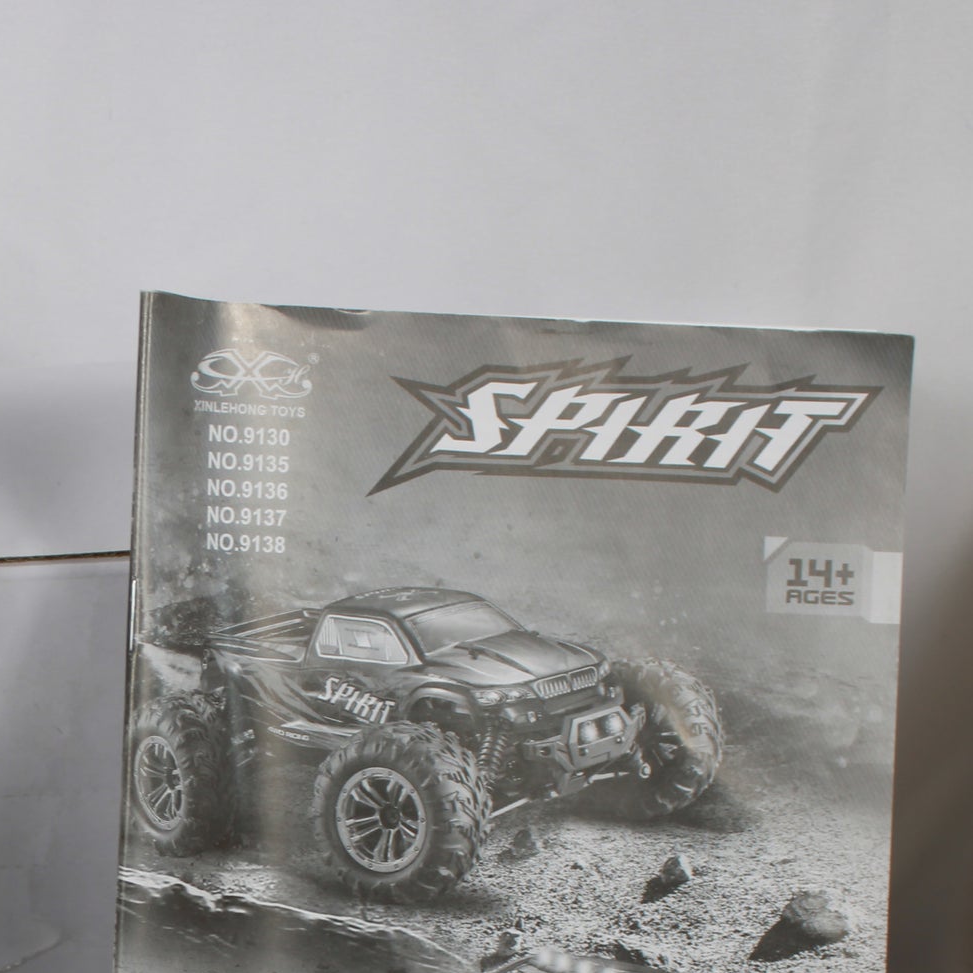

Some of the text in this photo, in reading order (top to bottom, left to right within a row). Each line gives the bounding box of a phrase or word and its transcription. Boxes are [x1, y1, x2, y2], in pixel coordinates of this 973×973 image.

[193, 399, 306, 418] XINLEHONG TOYS
[208, 424, 290, 447] NO.9130
[430, 381, 852, 472] SPIRIT
[207, 451, 289, 473] NO.9135
[207, 478, 288, 500] NO.9136
[206, 505, 287, 526] NO.9137
[206, 532, 285, 553] NO.9138
[786, 558, 855, 588] 14+
[785, 589, 855, 606] AGES
[319, 677, 395, 724] SPIRIT
